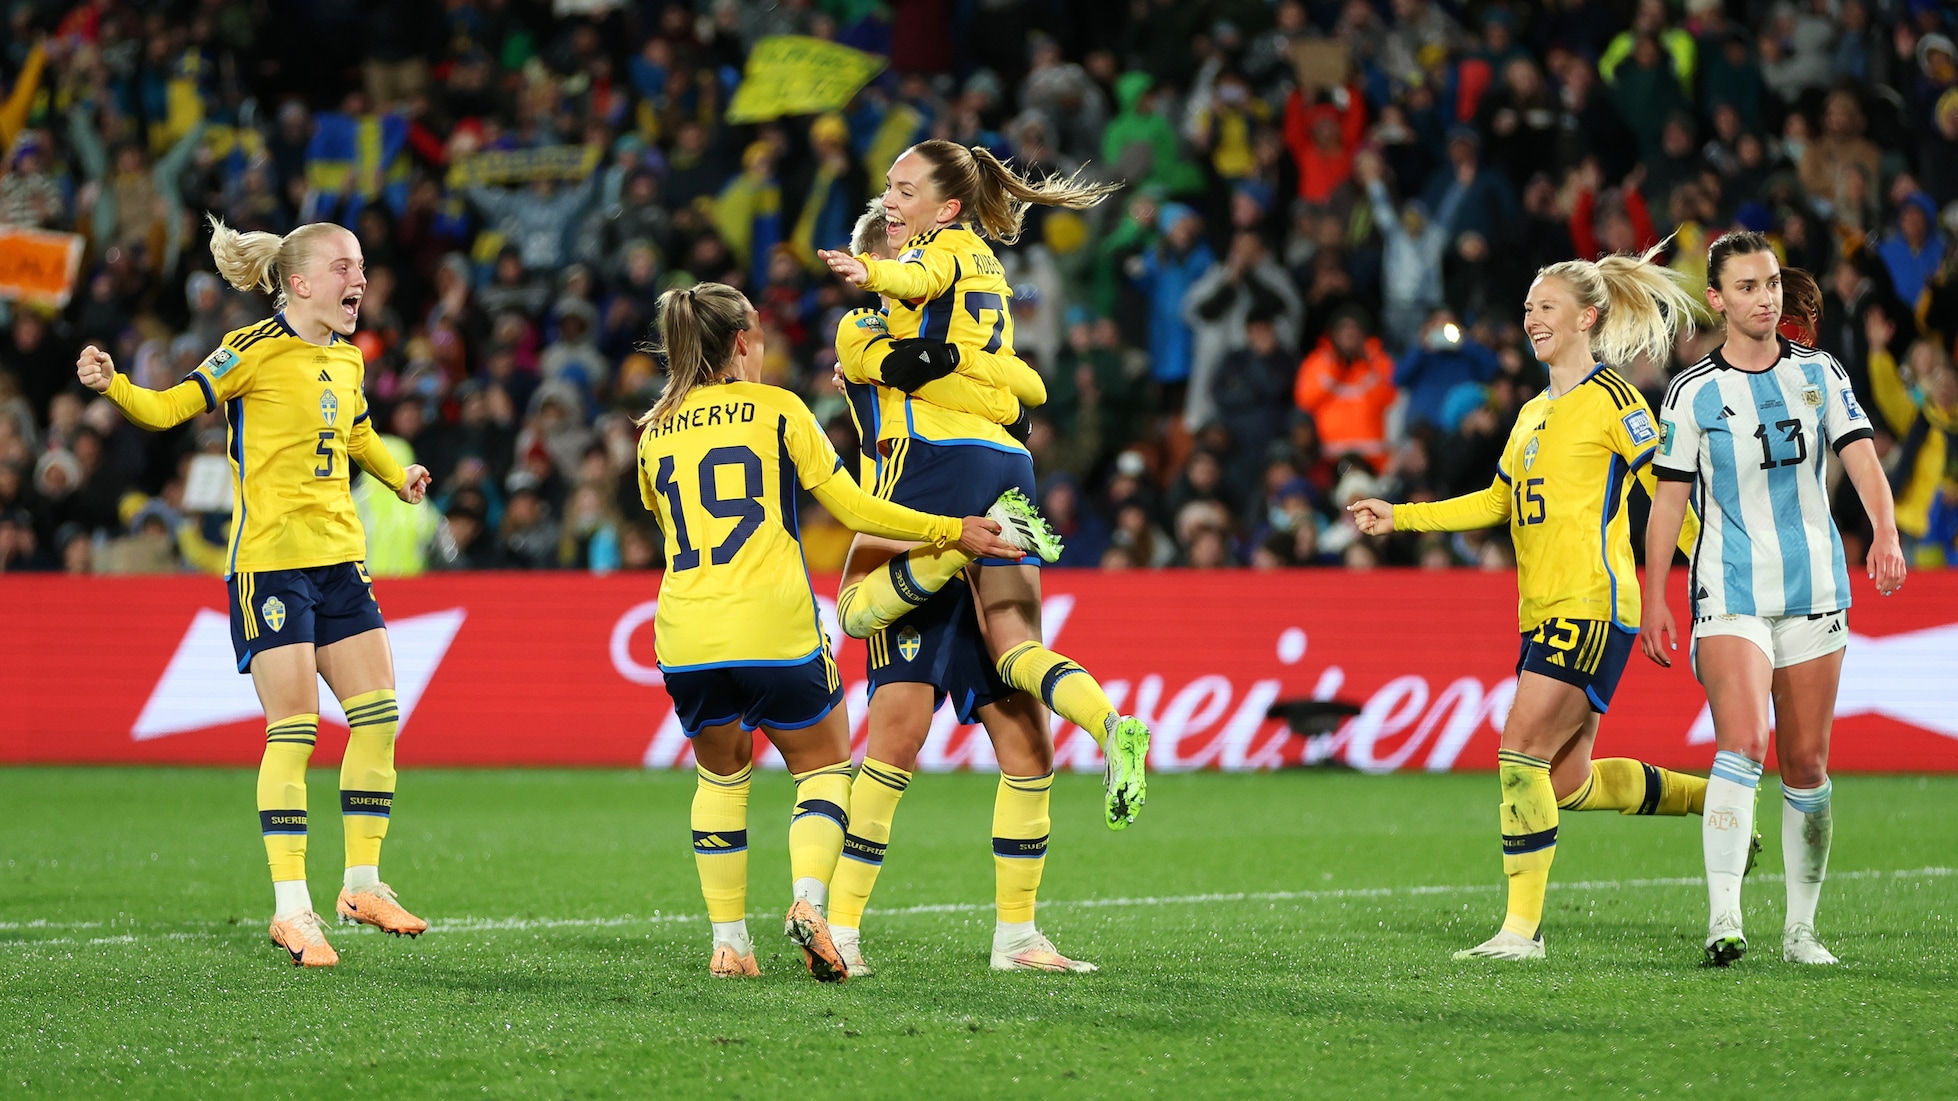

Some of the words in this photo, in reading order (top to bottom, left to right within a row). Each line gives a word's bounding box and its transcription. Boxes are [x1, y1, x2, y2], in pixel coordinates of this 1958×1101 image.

[314, 431, 336, 478] 5
[1753, 418, 1808, 471] 13
[655, 445, 766, 573] 19
[1514, 477, 1547, 528] 15
[270, 815, 308, 826] SVERIG
[1707, 809, 1740, 831] AFA
